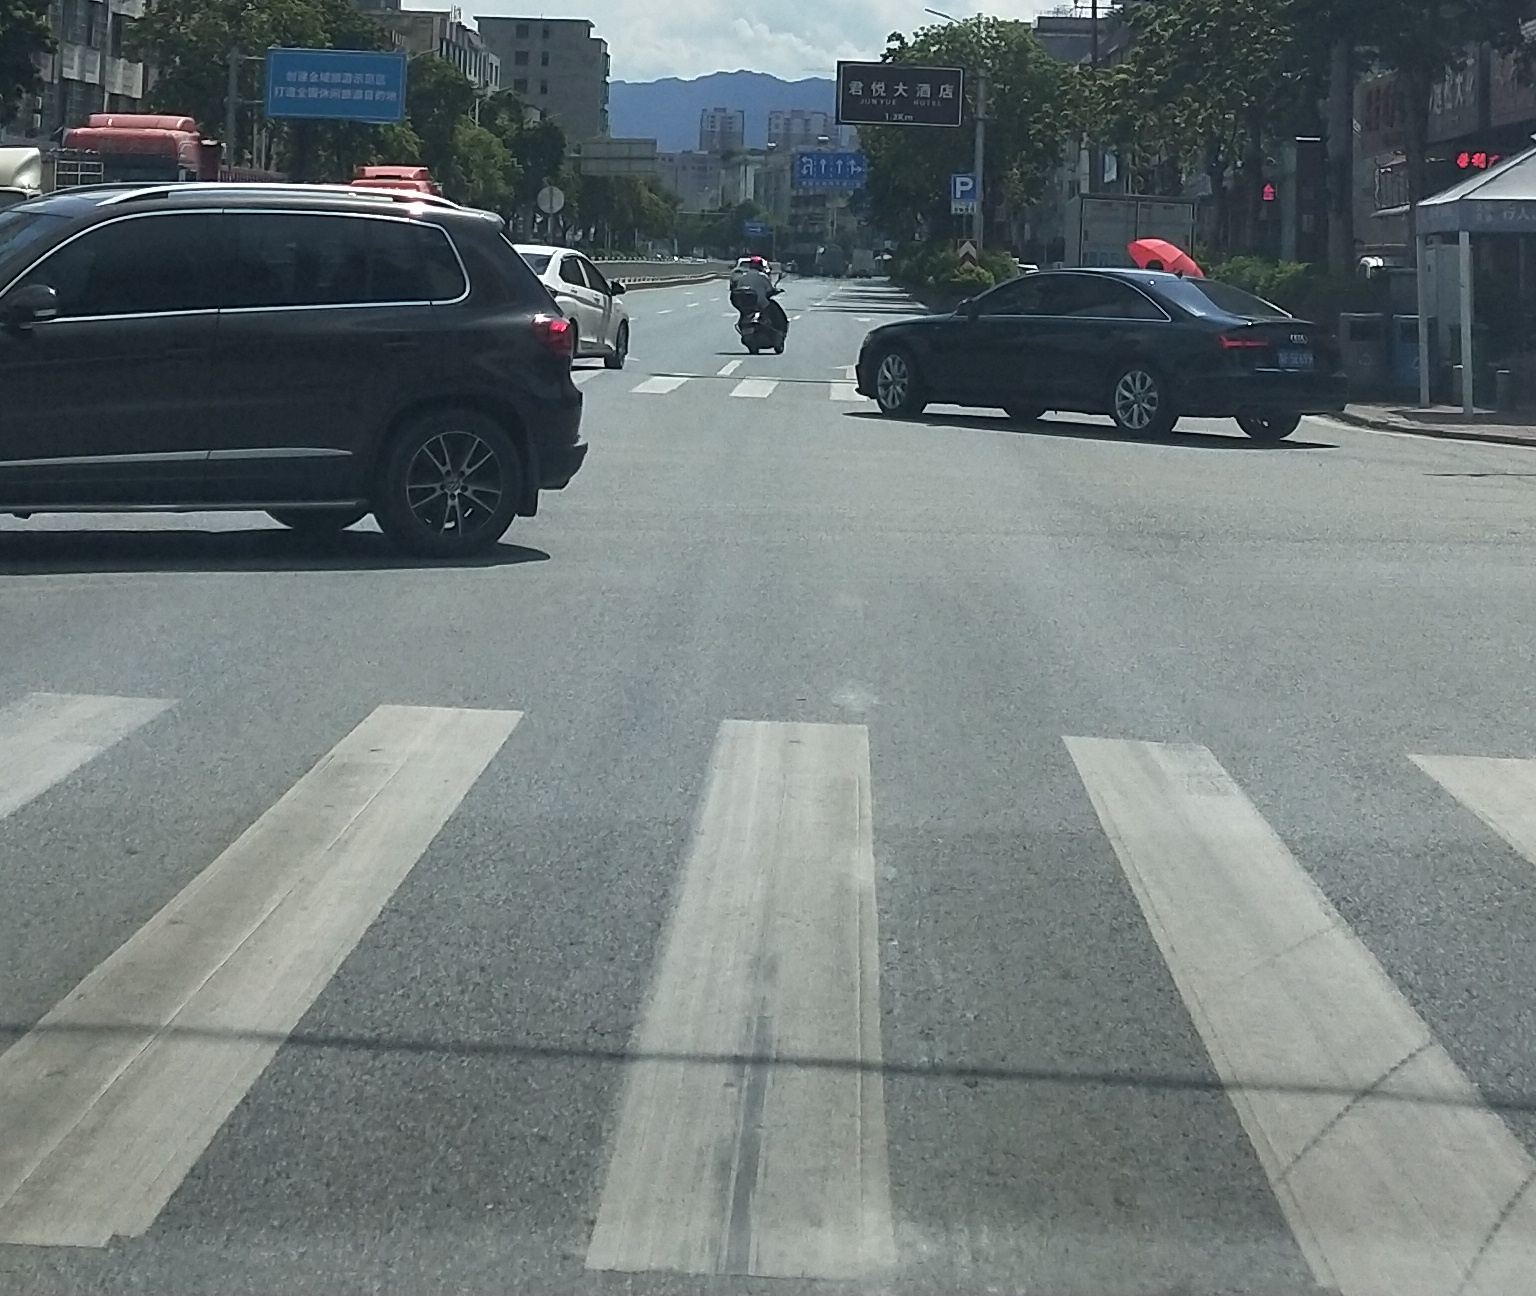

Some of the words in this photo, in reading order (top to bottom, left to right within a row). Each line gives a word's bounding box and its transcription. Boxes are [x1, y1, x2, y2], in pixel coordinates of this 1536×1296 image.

[848, 80, 954, 99] 君悦大酒店
[913, 99, 941, 107] HOTEL
[954, 176, 974, 198] P
